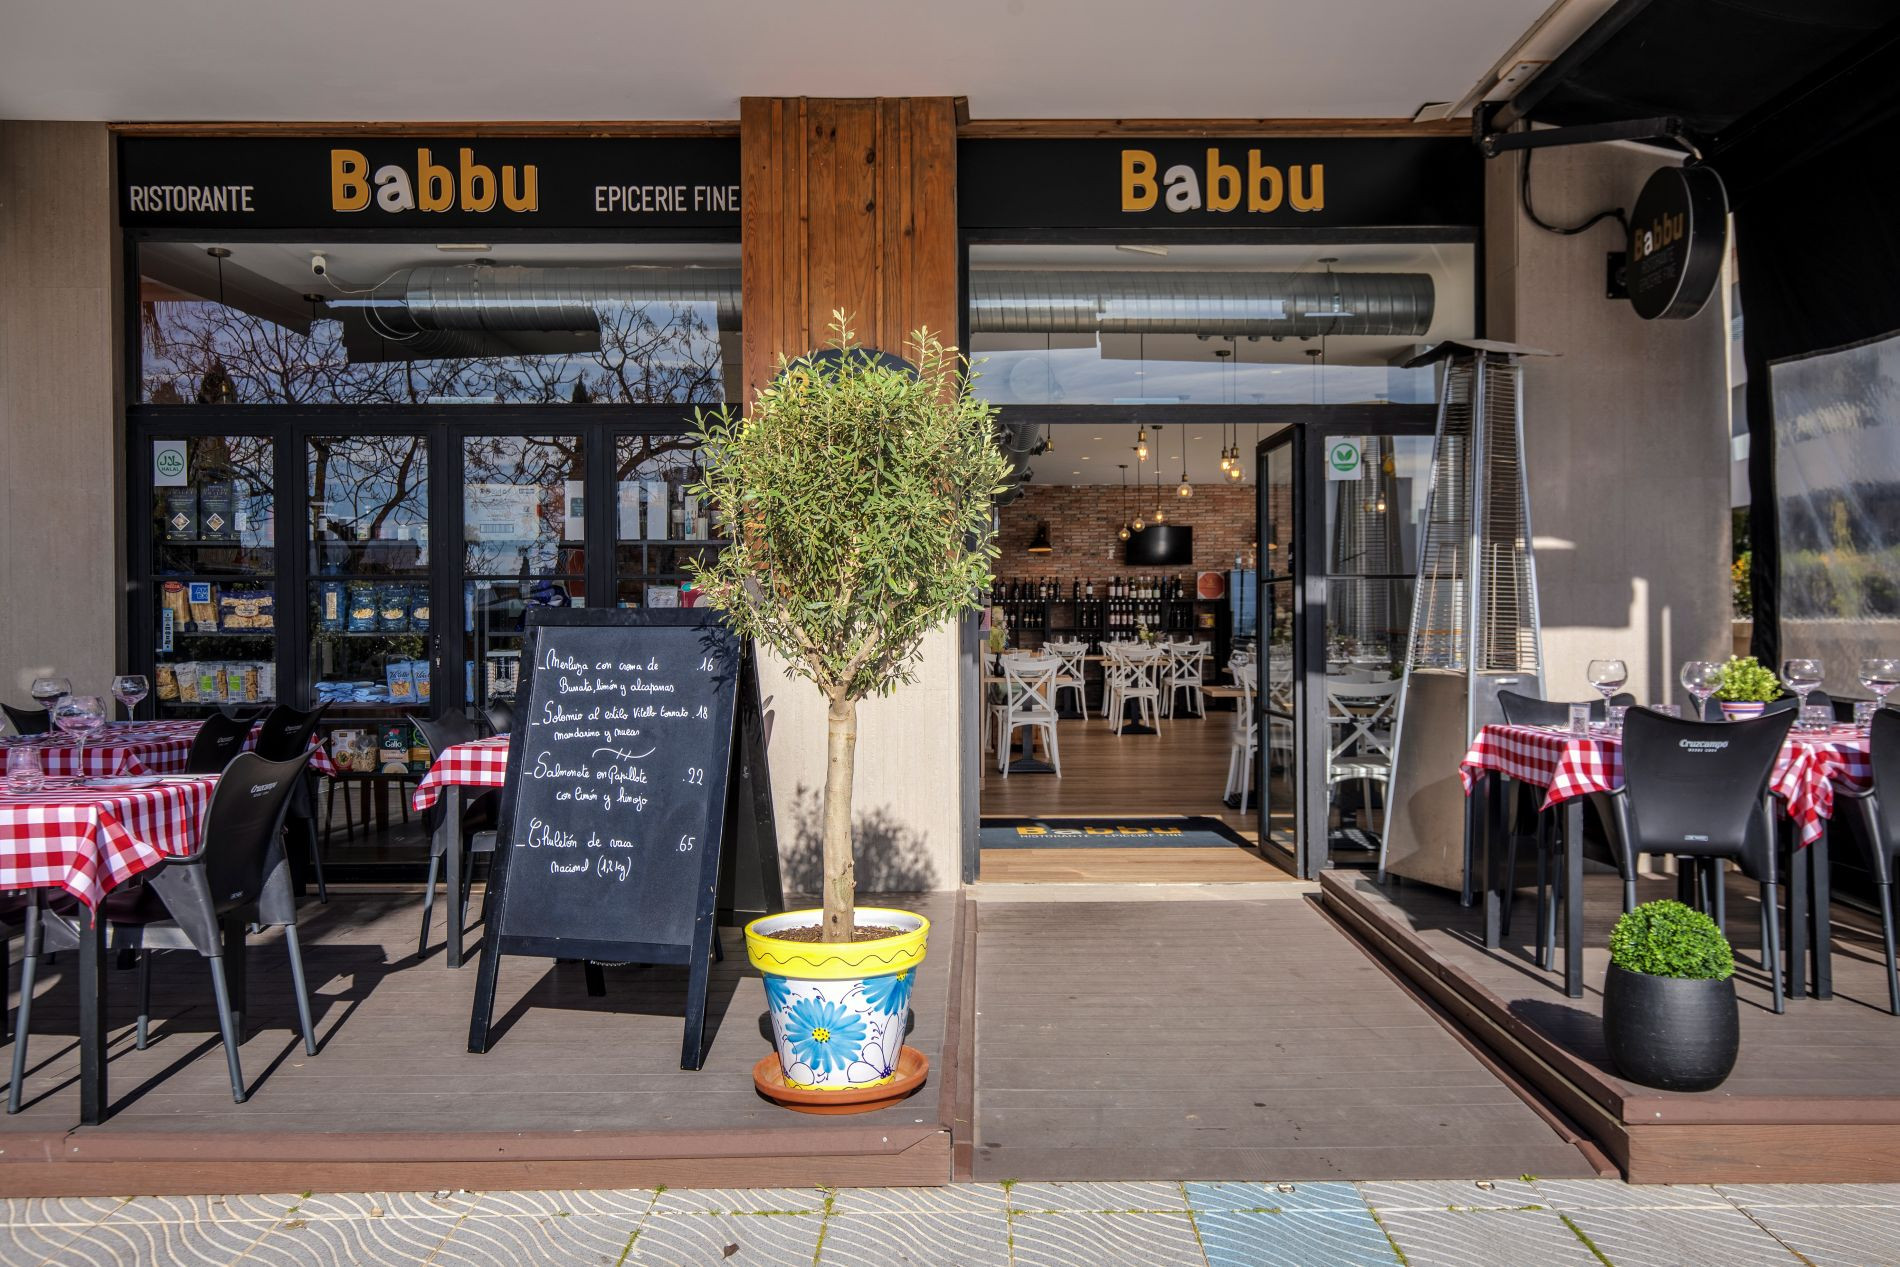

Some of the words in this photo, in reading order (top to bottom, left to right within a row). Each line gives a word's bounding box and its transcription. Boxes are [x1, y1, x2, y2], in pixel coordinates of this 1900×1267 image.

[329, 147, 539, 214] Babbu
[1120, 147, 1325, 213] Babbu
[129, 184, 256, 214] RISTORANTE
[594, 185, 688, 213] EPICERIE
[694, 185, 740, 212] FINE
[1633, 211, 1684, 263] Babbu
[595, 661, 612, 670] con
[646, 656, 659, 671] de
[619, 684, 627, 697] y
[587, 706, 601, 721] al
[604, 705, 629, 720] estilo
[384, 739, 404, 749] Gallo
[603, 730, 612, 743] y
[555, 791, 572, 801] con
[603, 794, 611, 811] y
[1016, 826, 1183, 835] Babbu
[587, 831, 602, 848] de
